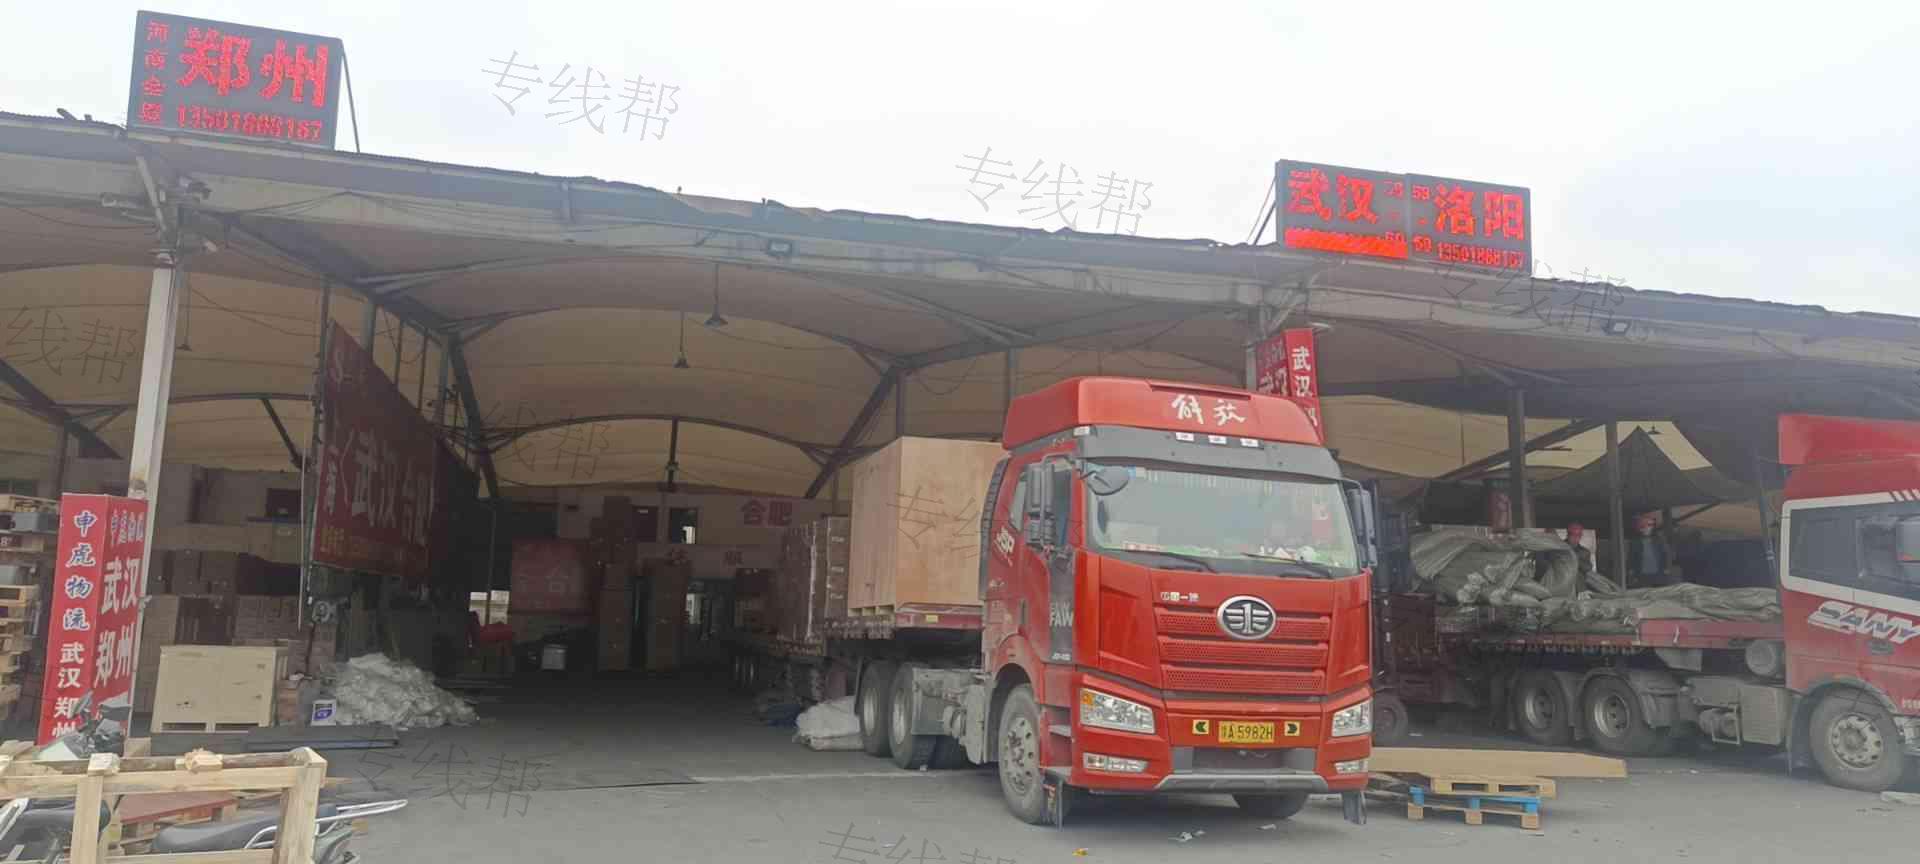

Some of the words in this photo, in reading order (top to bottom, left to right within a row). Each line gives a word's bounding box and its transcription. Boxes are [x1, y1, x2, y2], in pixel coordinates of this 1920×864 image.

[176, 27, 329, 108] 郑州
[1285, 168, 1379, 224] 武汉
[1434, 184, 1526, 240] 洛阳
[63, 510, 97, 632] 申虎物流
[102, 557, 143, 614] 武汉
[94, 624, 137, 687] 郑州
